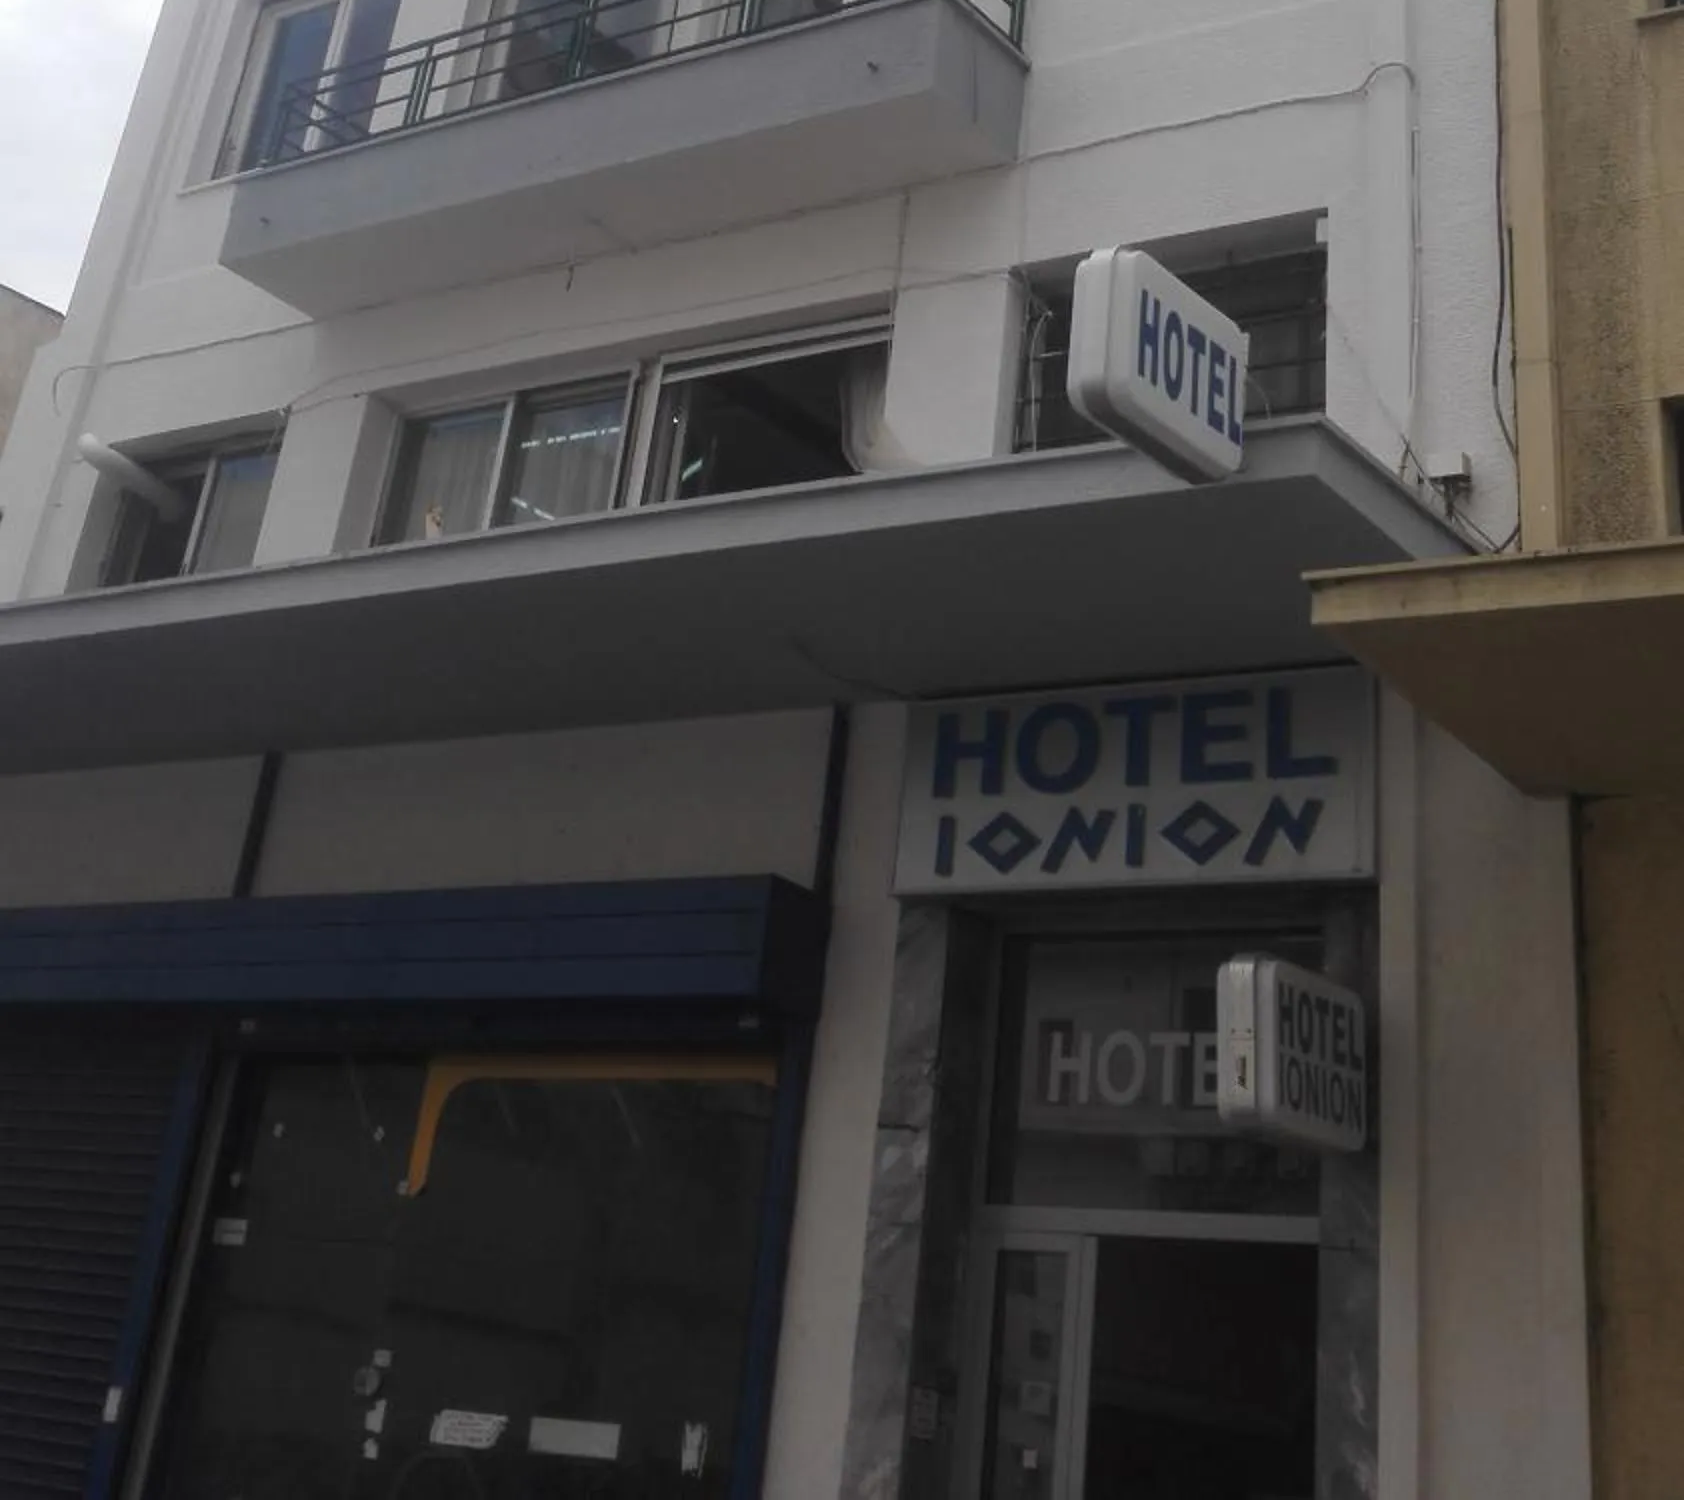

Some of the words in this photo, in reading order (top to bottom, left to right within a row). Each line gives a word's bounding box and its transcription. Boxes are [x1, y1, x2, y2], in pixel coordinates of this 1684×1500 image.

[1138, 288, 1244, 449] HOTEL
[933, 687, 1338, 798] HOTEL
[935, 795, 1326, 877] IONION
[1046, 1030, 1218, 1107] HOTE
[1279, 981, 1362, 1072] HOTEL
[1279, 1052, 1362, 1133] IONION
